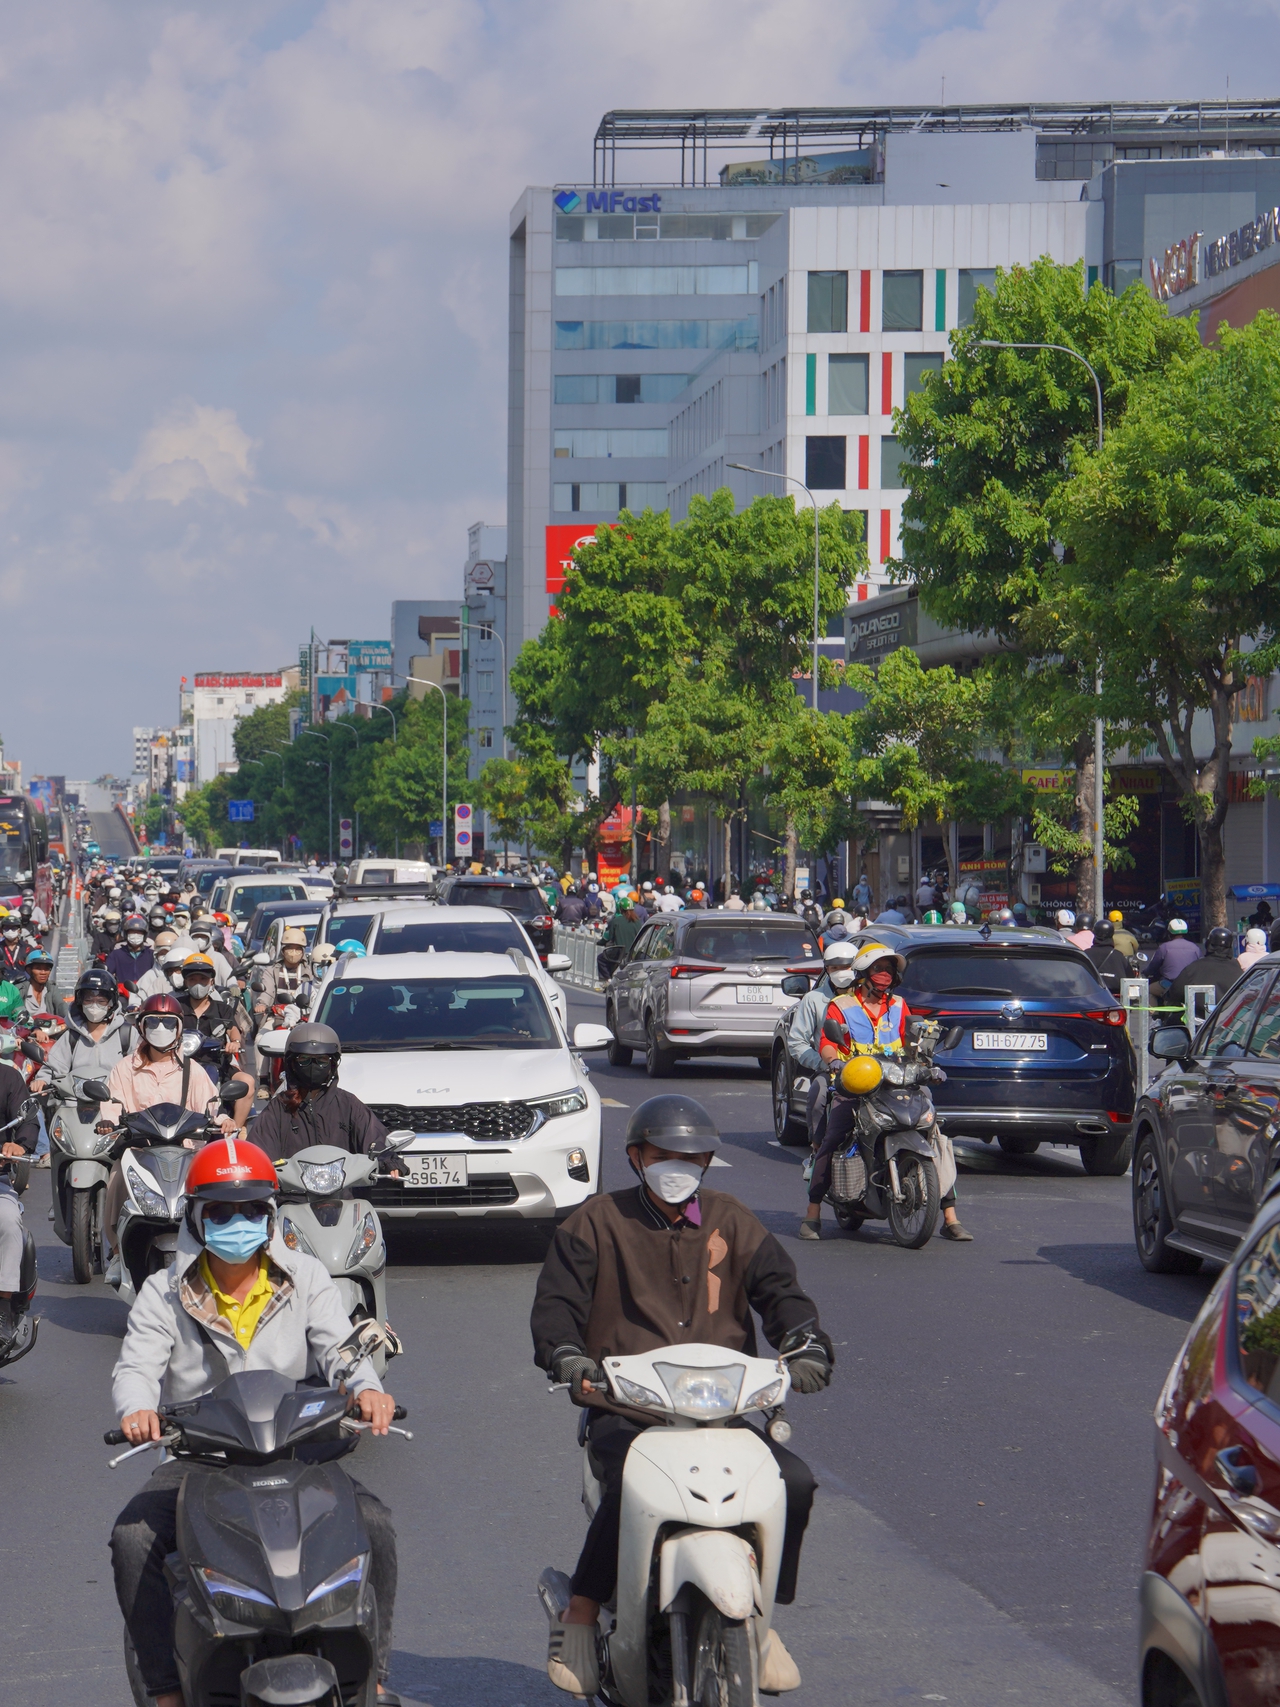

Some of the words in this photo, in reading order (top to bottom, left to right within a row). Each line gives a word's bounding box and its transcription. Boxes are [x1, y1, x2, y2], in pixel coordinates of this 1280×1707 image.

[586, 191, 662, 213] MFast
[1040, 900, 1073, 908] KHÔNG
[747, 986, 763, 994] 60K
[742, 994, 769, 1003] 160.81
[976, 1034, 1046, 1049] 51H-677.75
[421, 1157, 448, 1170] 51K
[216, 1165, 253, 1176] SanDisk
[252, 1478, 289, 1487] HONDA
